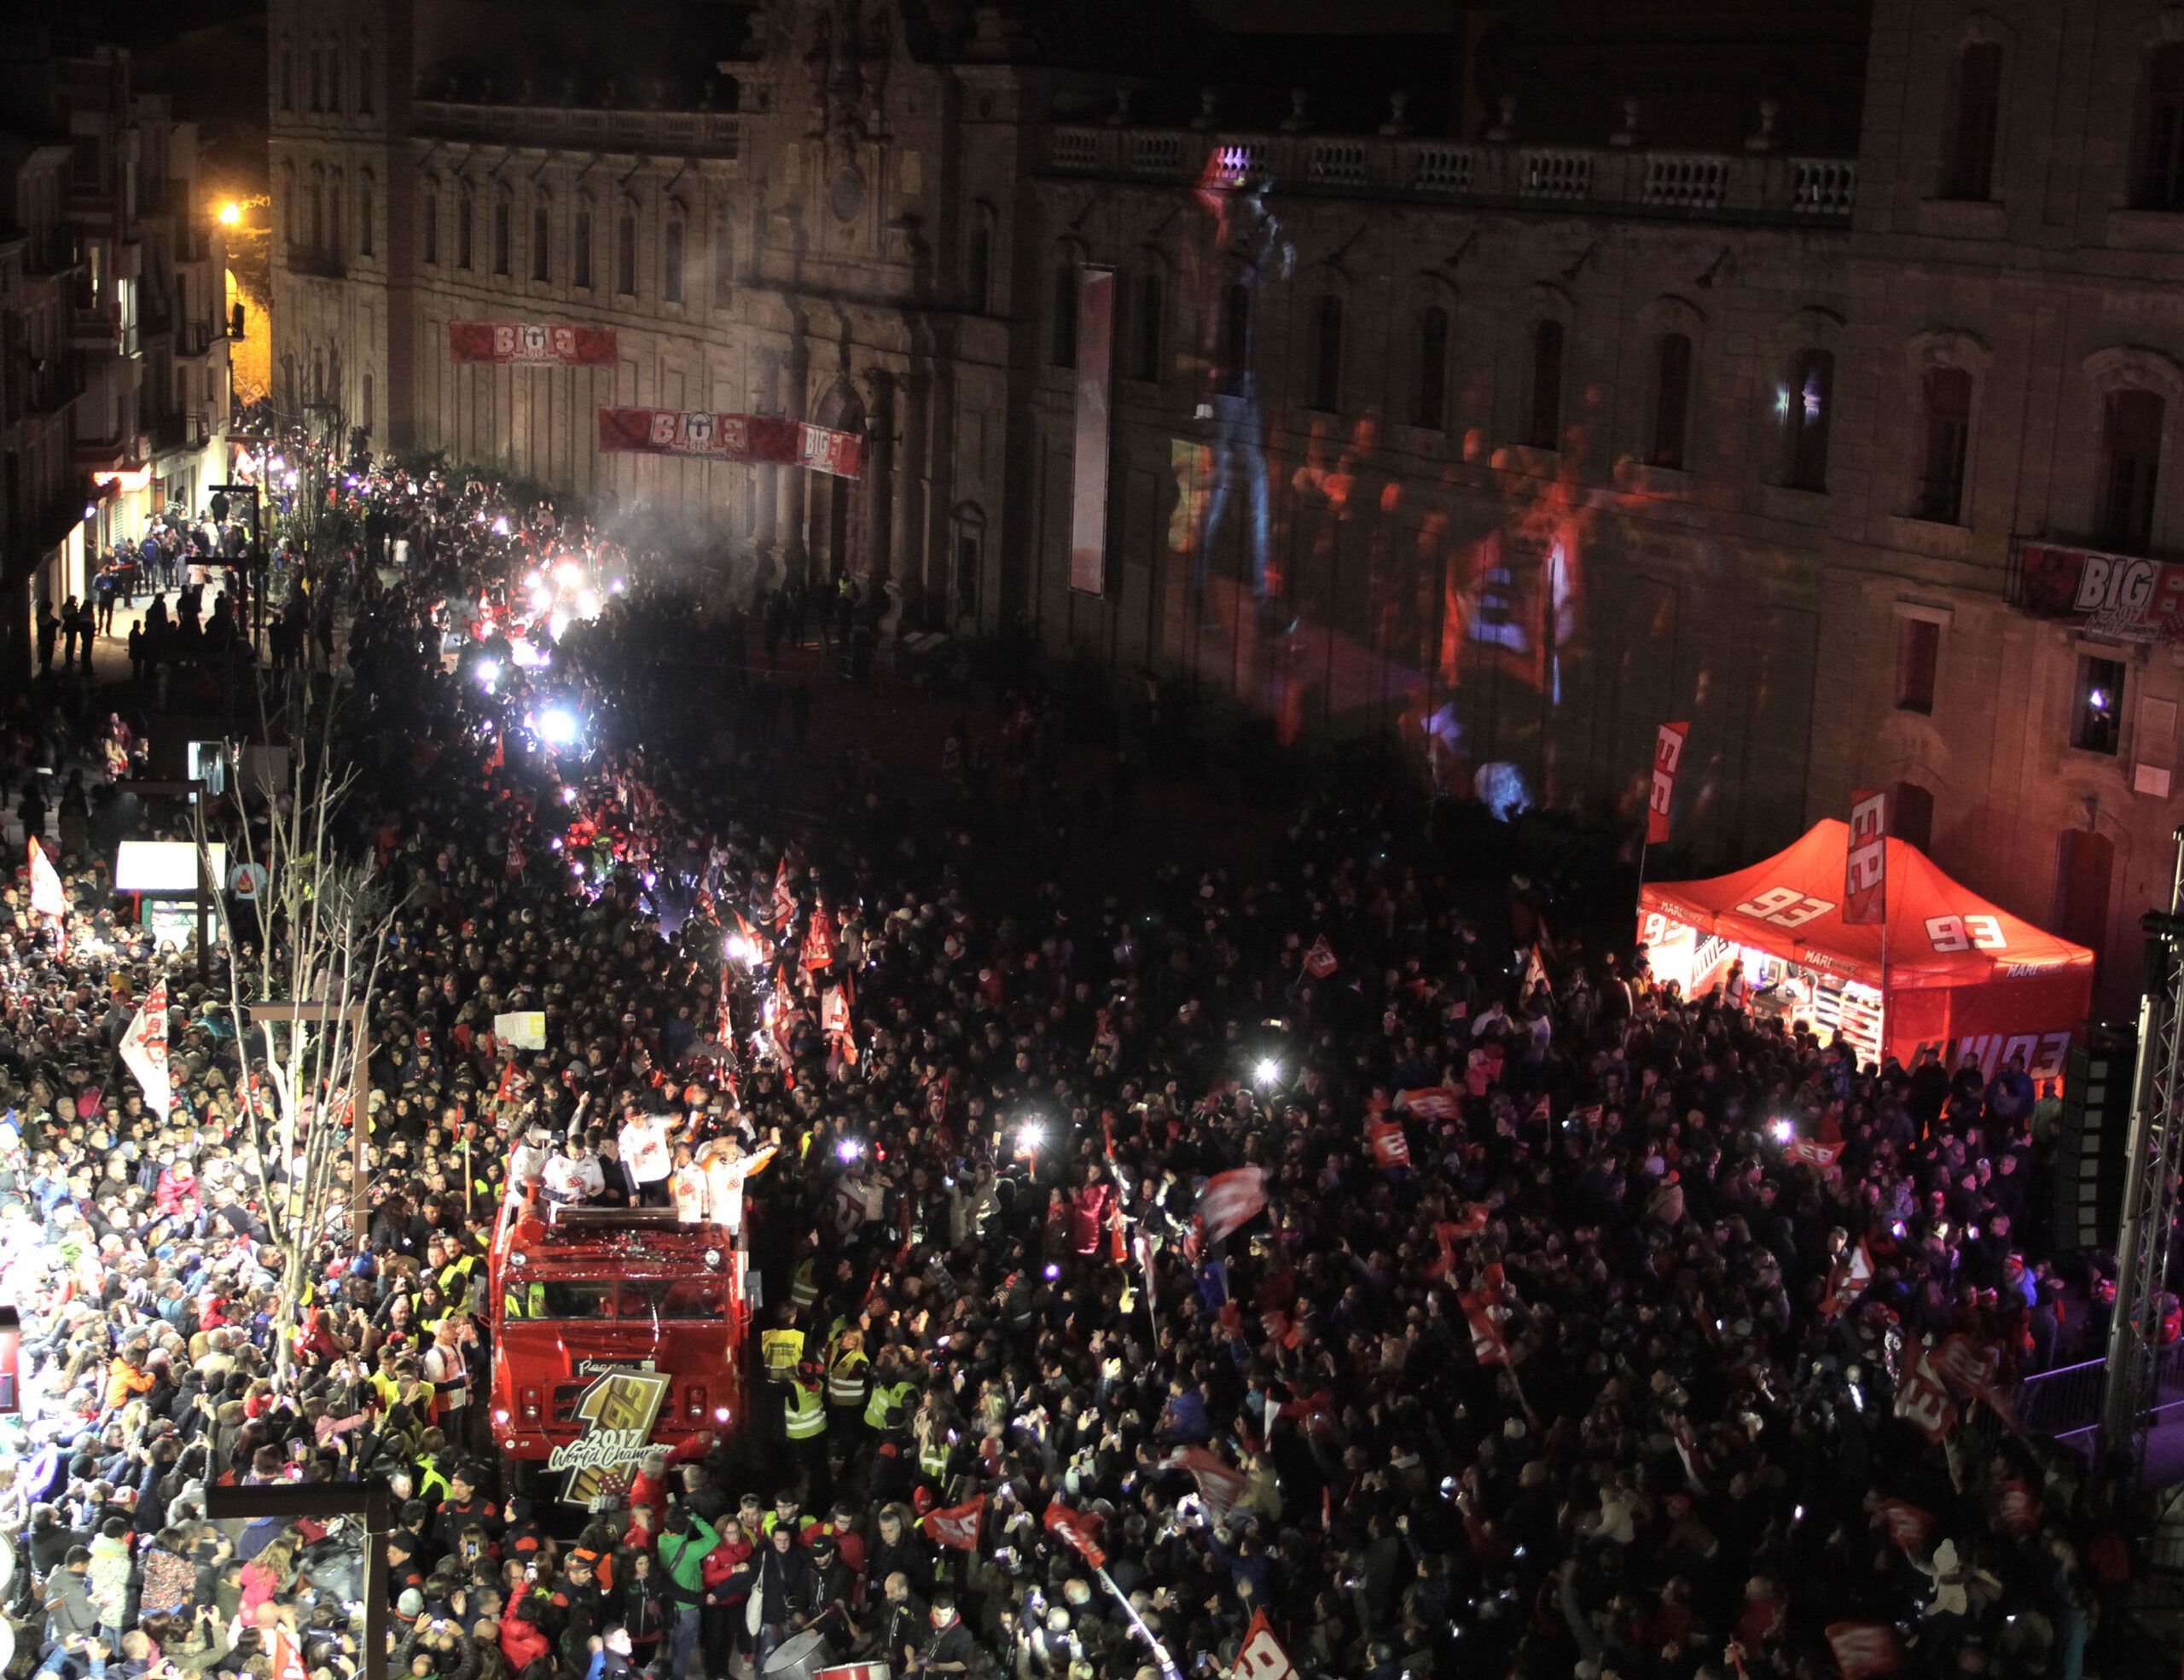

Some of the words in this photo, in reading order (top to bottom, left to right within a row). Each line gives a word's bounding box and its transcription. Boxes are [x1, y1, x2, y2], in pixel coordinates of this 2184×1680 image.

[2077, 555, 2153, 611] BIG
[1735, 887, 1837, 927] 93
[1925, 915, 2007, 951] 93
[551, 1441, 600, 1468] World
[589, 1428, 644, 1449] 2017
